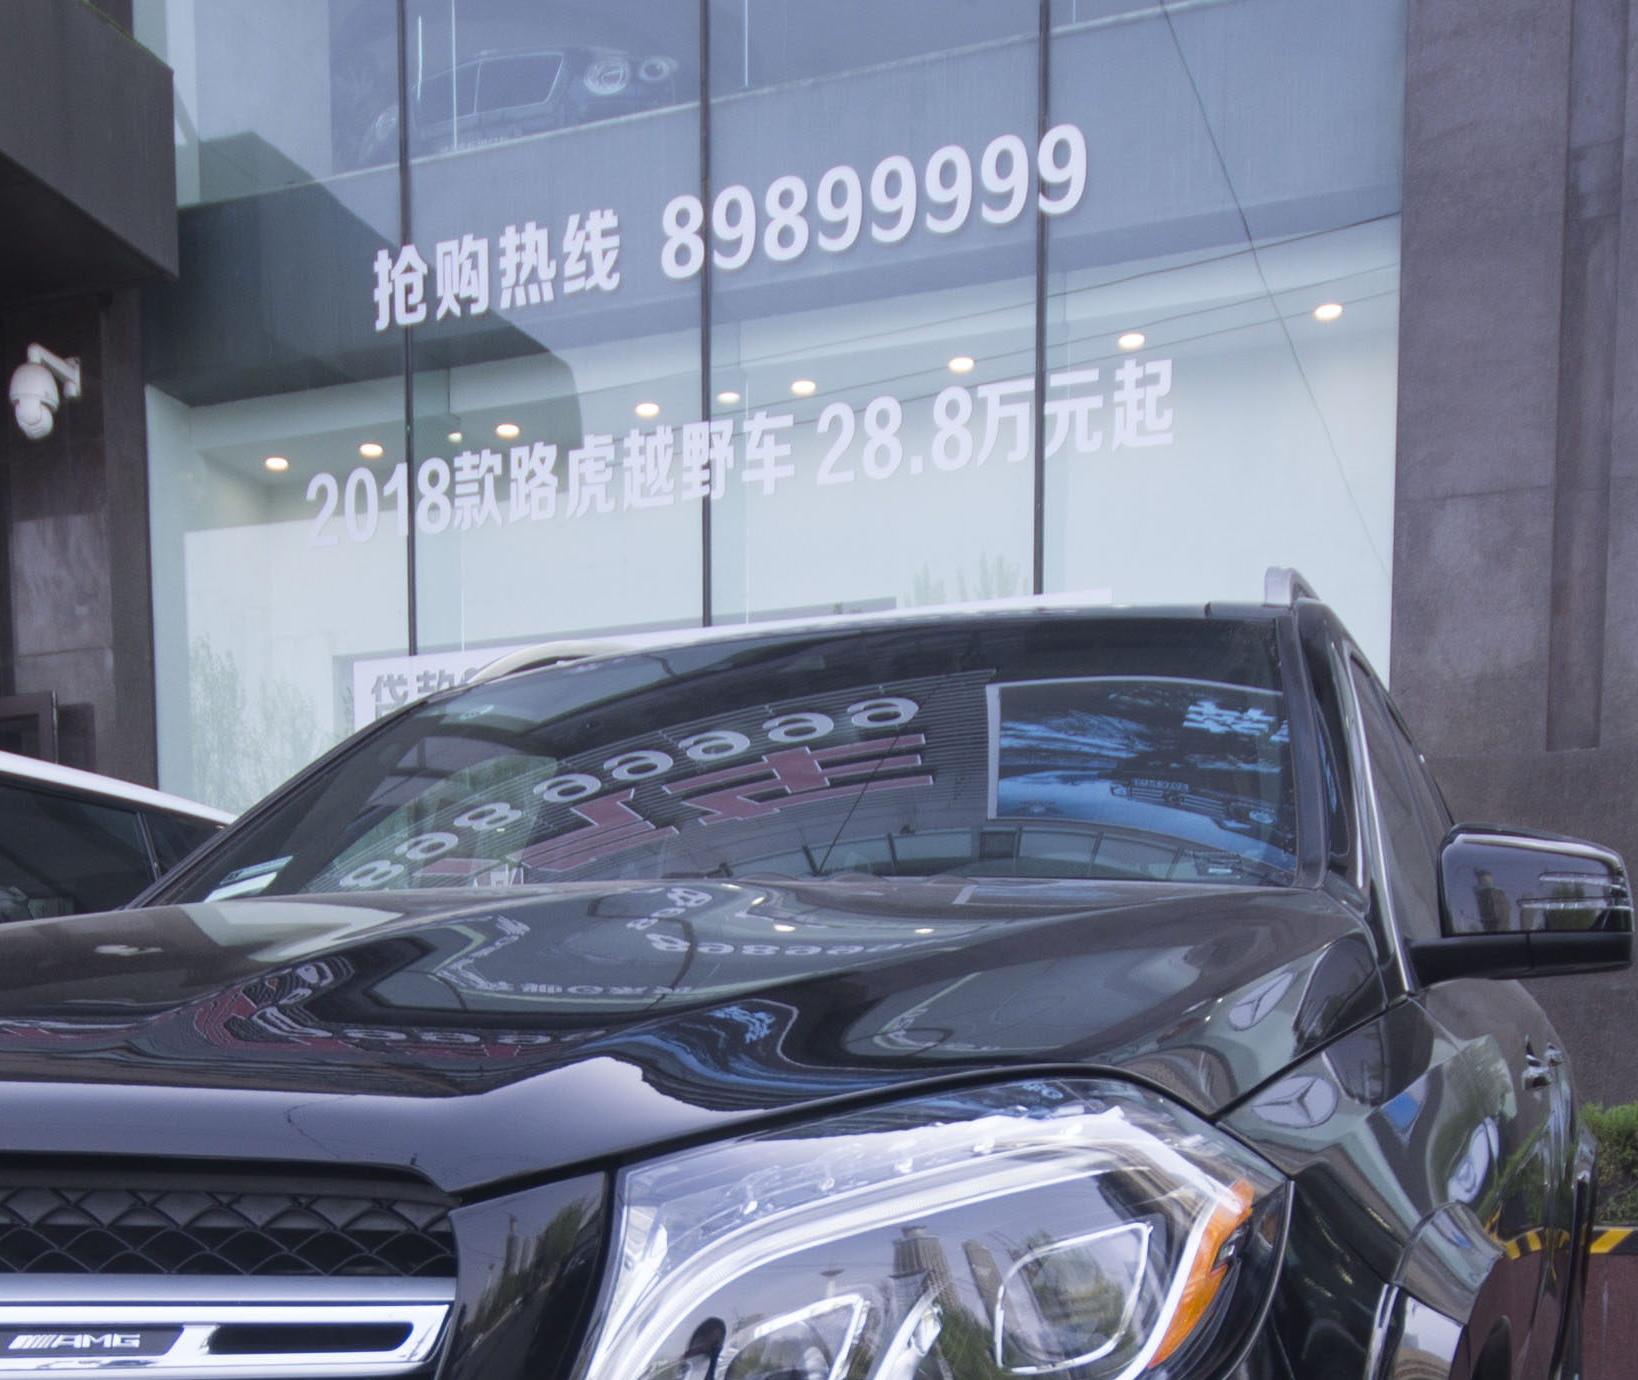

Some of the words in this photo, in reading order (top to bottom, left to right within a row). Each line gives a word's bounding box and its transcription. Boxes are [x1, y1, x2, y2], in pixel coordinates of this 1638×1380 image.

[371, 209, 622, 332] 抢购热线
[660, 123, 1089, 280] 89899999
[304, 411, 797, 548] 2018款路虎越野车
[815, 358, 1175, 488] 28.8万元起
[50, 1333, 141, 1350] AMG
